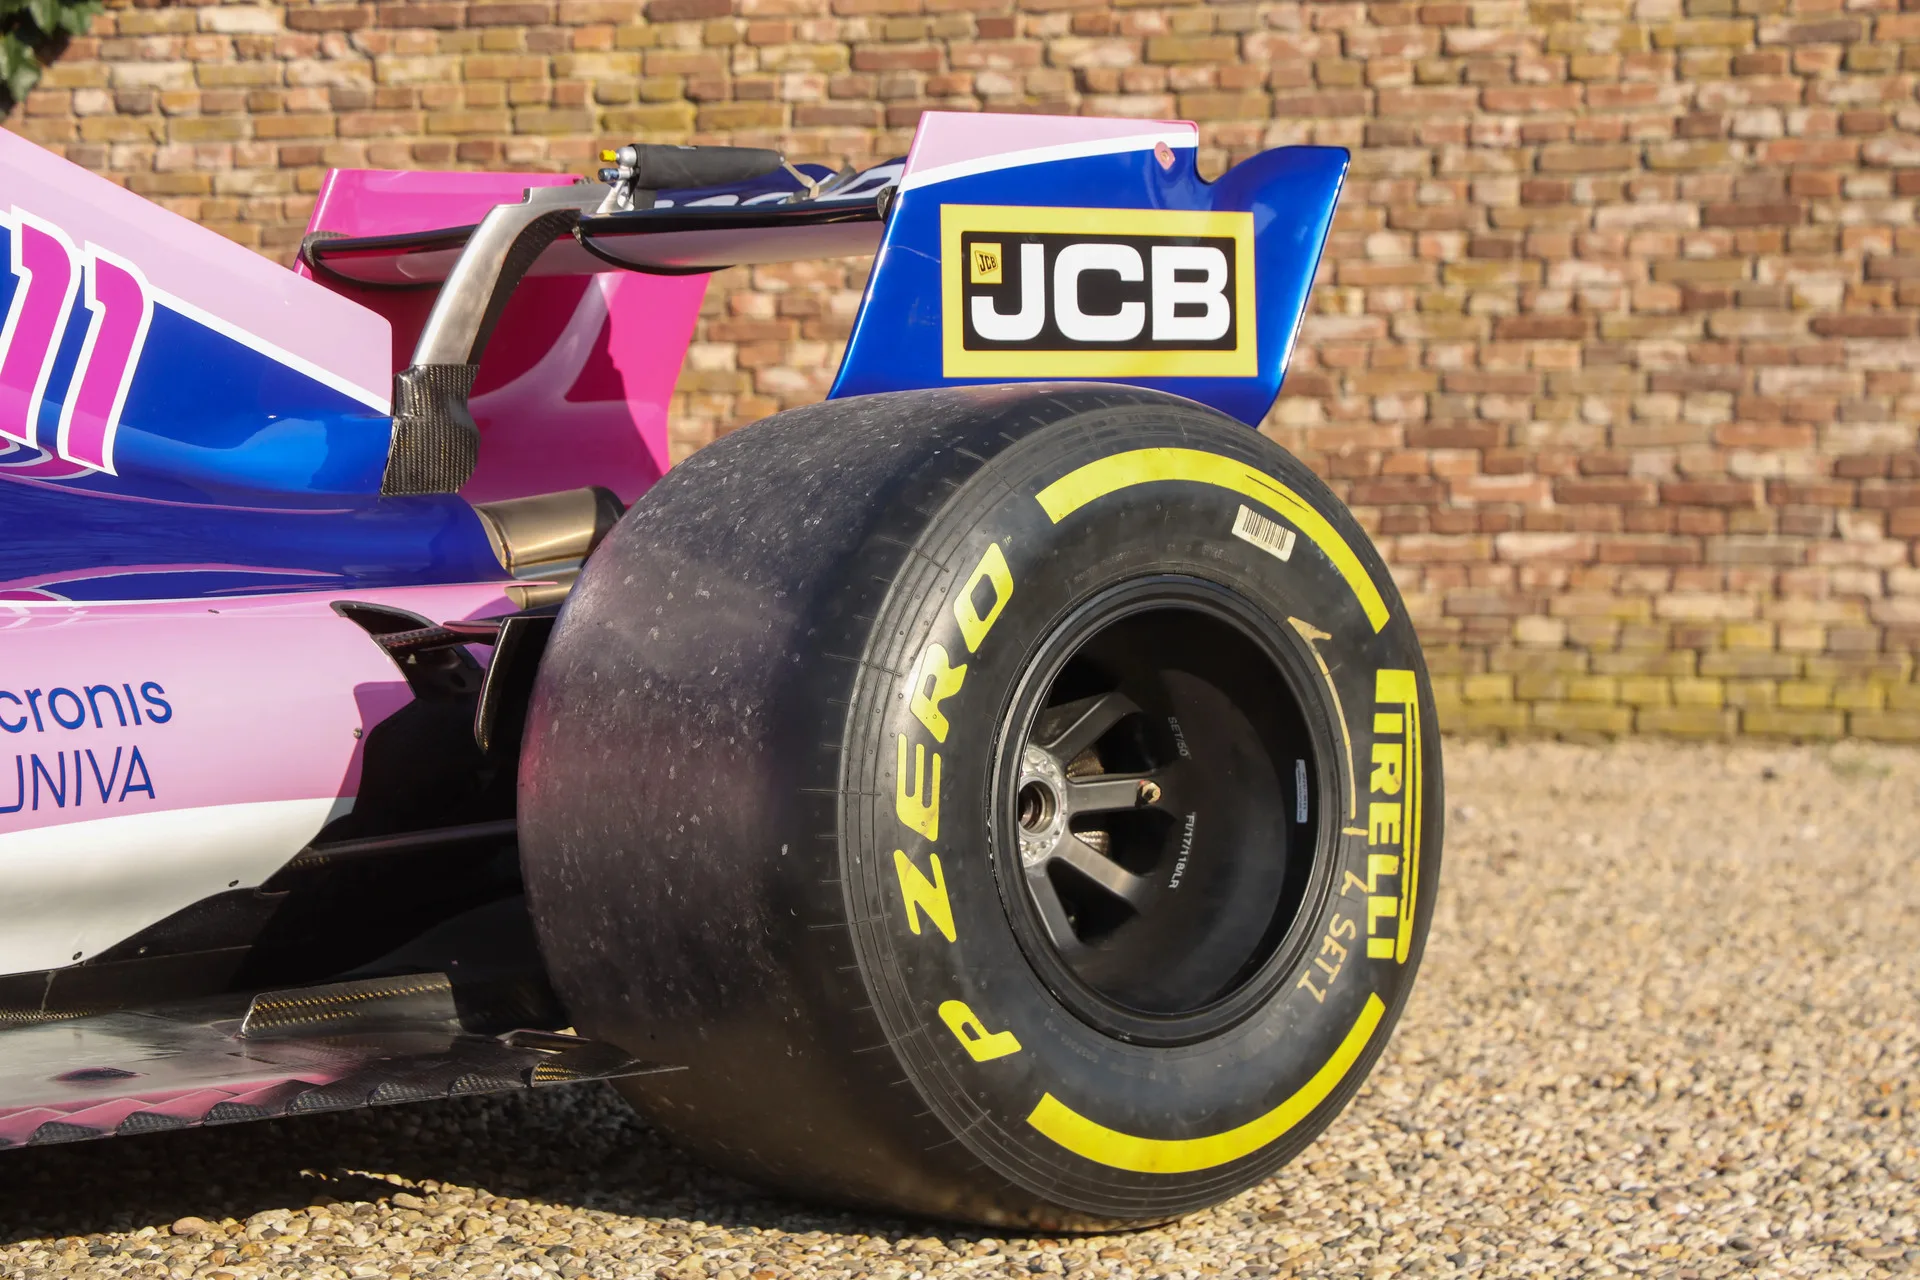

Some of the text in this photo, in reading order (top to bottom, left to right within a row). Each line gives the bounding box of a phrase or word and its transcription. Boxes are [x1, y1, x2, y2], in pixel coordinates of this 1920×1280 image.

[970, 243, 1231, 342] JCB
[979, 254, 997, 272] JCB
[893, 542, 1014, 943] ZERO
[1167, 716, 1191, 760] SET/50
[1366, 669, 1422, 964] PIRELLI
[938, 1000, 1022, 1062] P
